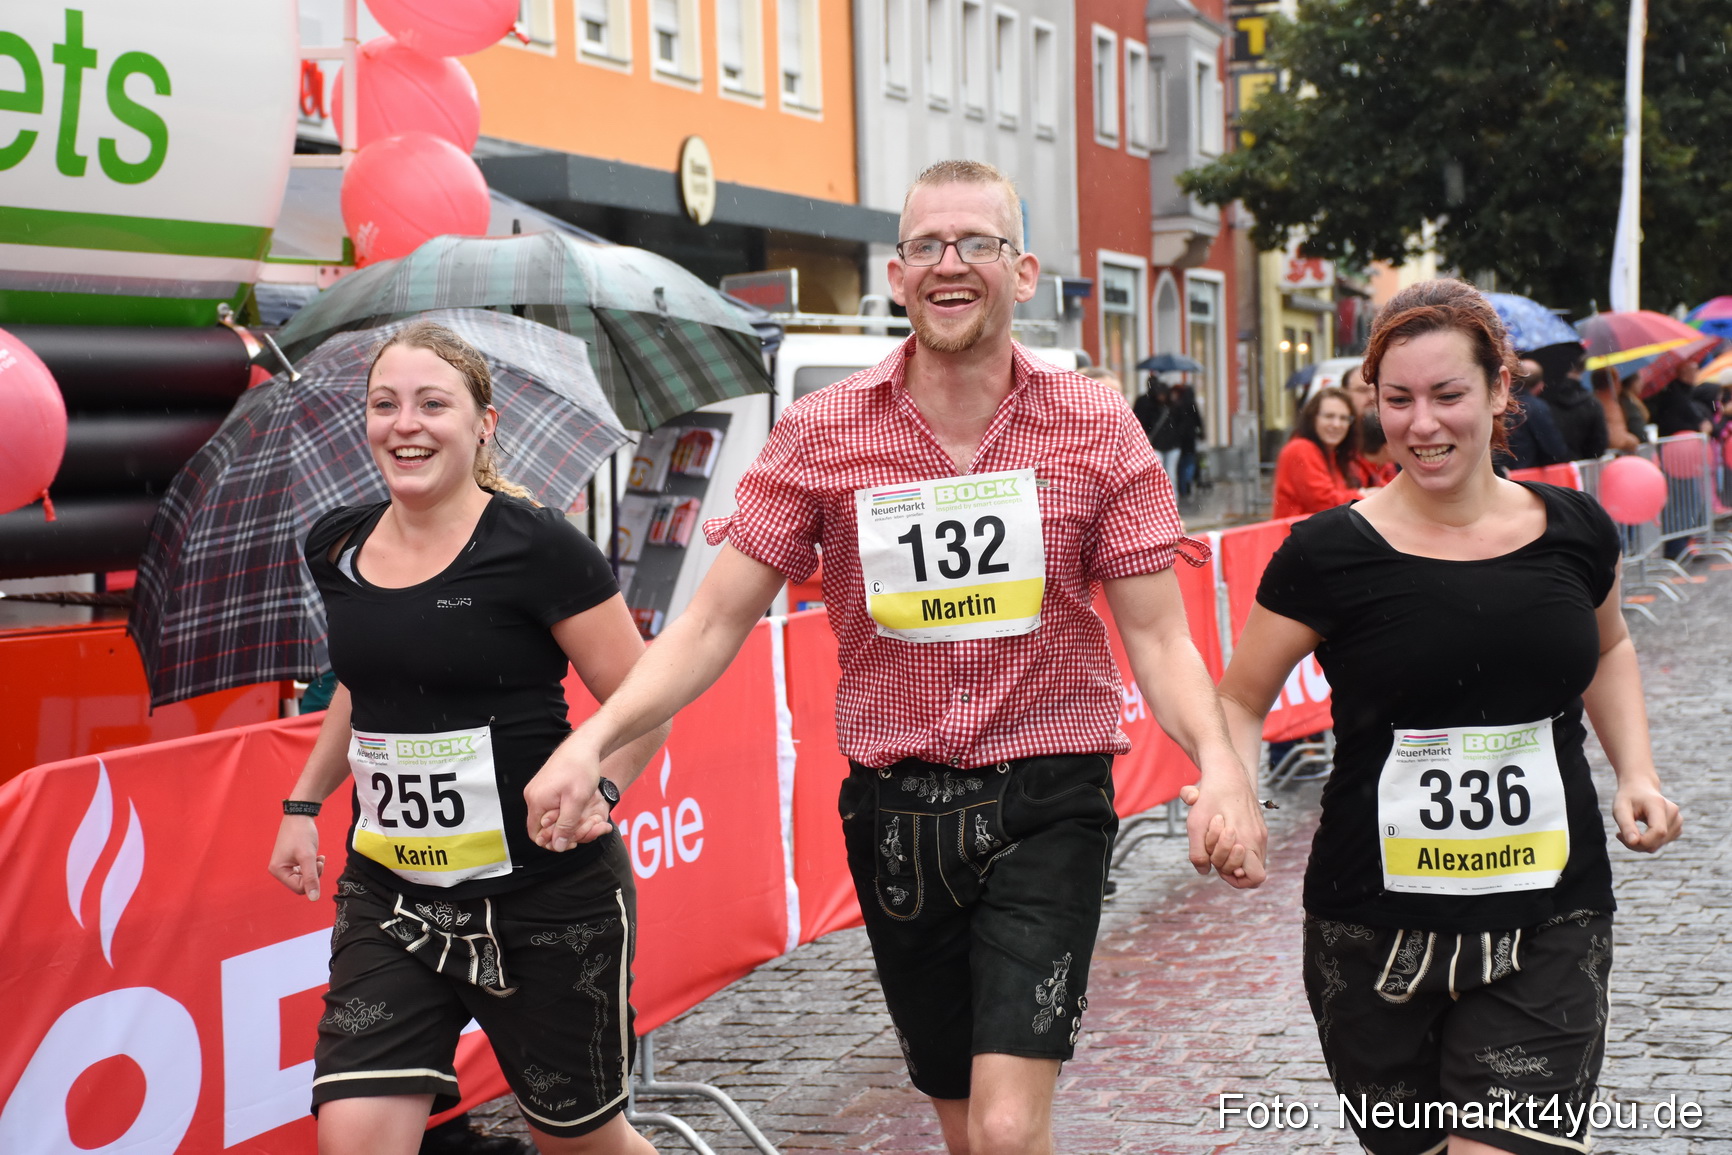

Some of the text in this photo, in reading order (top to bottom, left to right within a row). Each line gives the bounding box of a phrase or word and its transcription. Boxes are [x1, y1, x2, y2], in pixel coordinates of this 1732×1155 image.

[934, 477, 1021, 505] BOCK
[871, 502, 926, 516] NeuerMarkt
[936, 504, 962, 512] inspired
[973, 500, 992, 508] smart
[897, 515, 1010, 583] 132
[921, 594, 996, 622] Martin
[395, 735, 476, 758] BOCK
[1395, 747, 1452, 758] NeuerMarkt
[1462, 727, 1540, 753] BOCK
[371, 772, 466, 829] 255
[1419, 764, 1531, 831] 336
[1388, 826, 1395, 836] D
[394, 845, 448, 866] Karin
[1417, 845, 1536, 871] Alexandra
